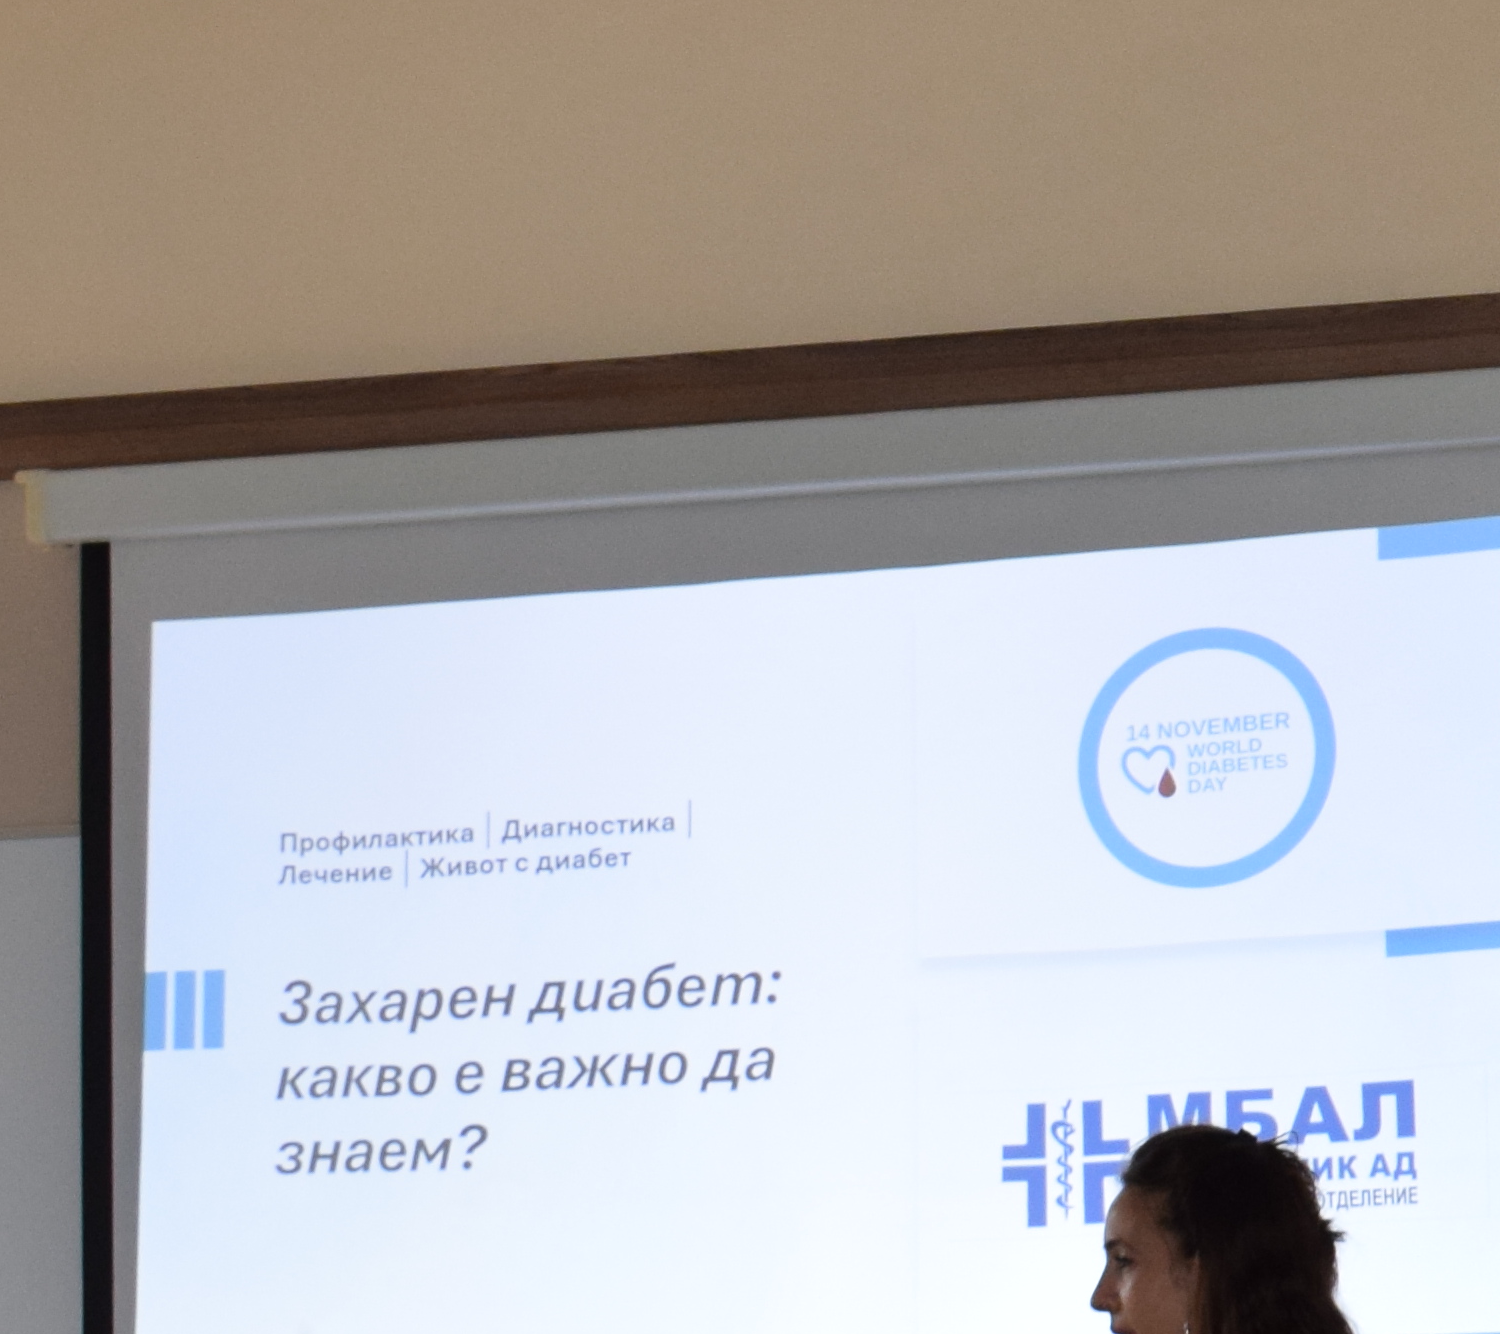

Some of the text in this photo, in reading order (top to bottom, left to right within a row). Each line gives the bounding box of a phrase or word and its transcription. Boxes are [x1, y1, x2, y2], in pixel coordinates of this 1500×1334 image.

[1127, 712, 1290, 742] 14 NOVEMBER
[1187, 738, 1262, 758] WORLD
[1187, 753, 1288, 776] DIABETES
[1188, 777, 1227, 794] DAY
[280, 814, 676, 856] Профилактика Диагностика
[279, 848, 632, 886] Лечение Живот с диабет
[279, 963, 783, 1032] Захарен диабет:
[275, 1044, 777, 1100] какво е важно да
[1146, 1080, 1416, 1145] МБАЛ
[274, 1124, 489, 1176] знаем?
[1369, 1151, 1418, 1181] АД
